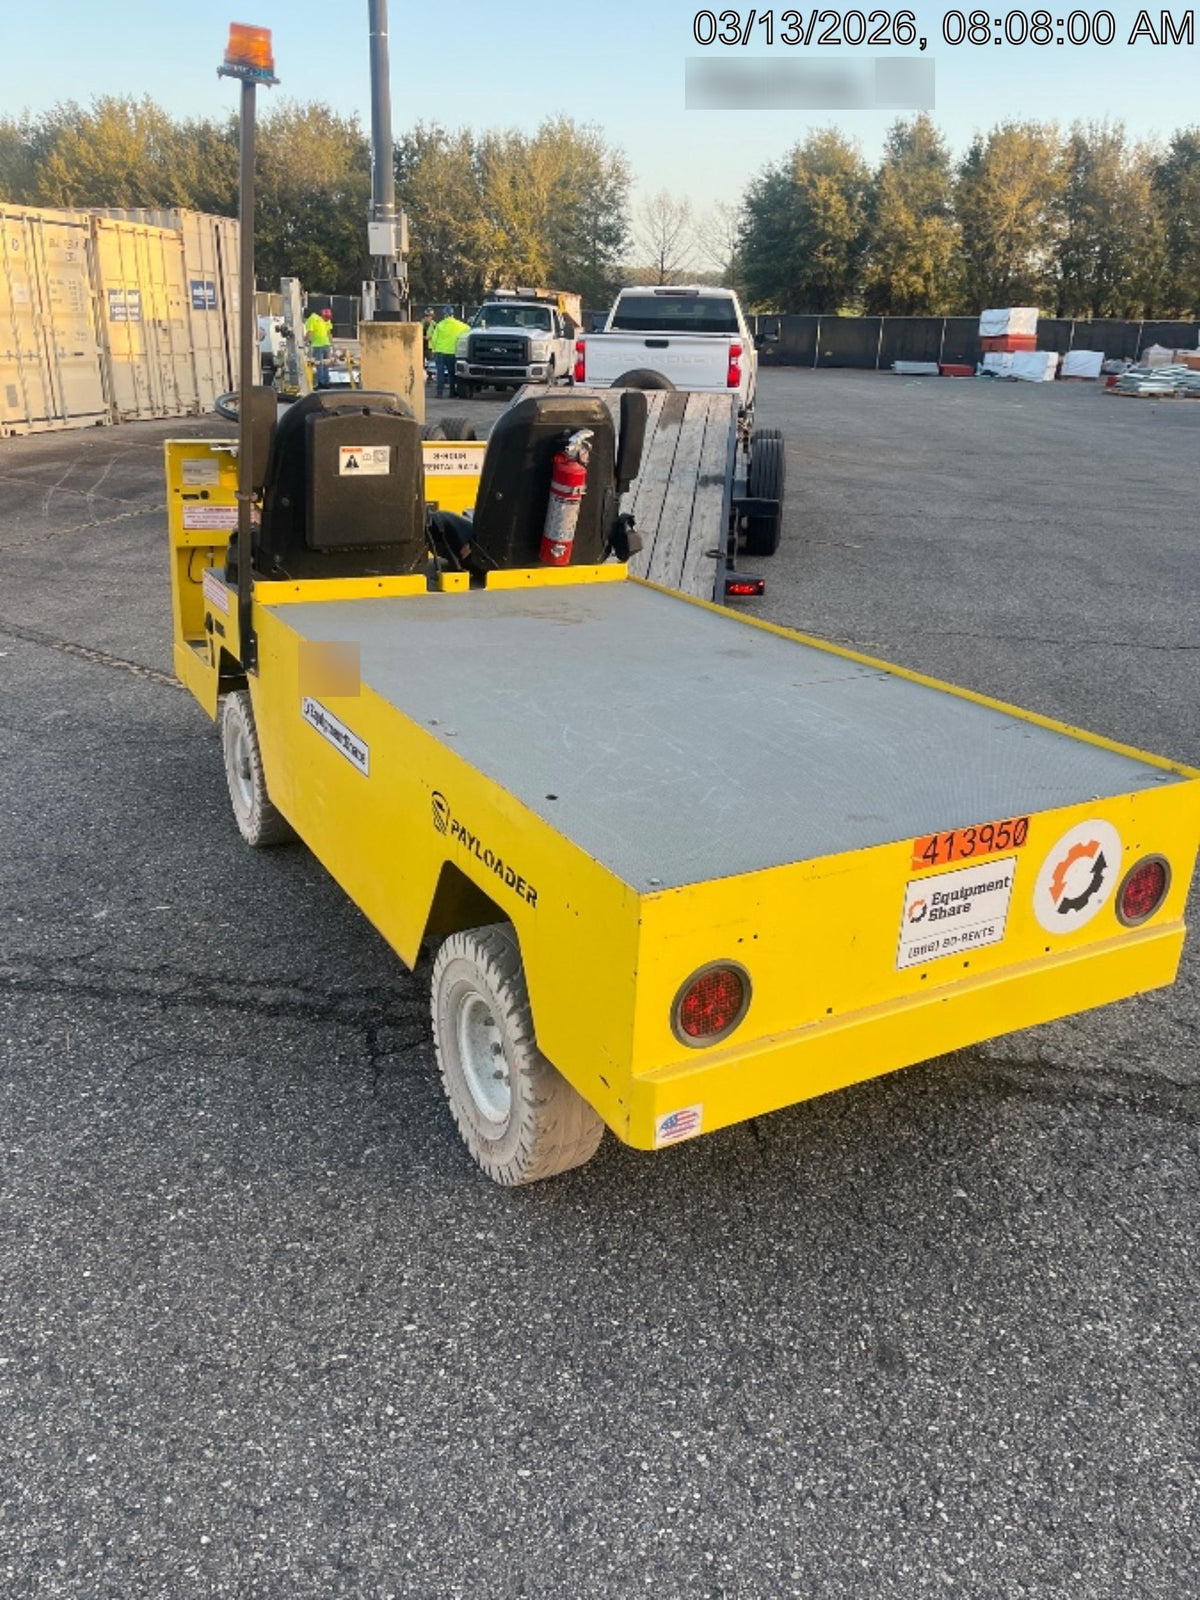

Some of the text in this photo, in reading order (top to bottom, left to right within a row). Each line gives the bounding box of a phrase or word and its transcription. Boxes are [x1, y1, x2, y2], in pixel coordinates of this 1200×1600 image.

[921, 817, 1030, 865] 413950
[450, 818, 538, 909] PAYLOADER
[931, 876, 1011, 906] Equipment
[927, 902, 972, 922] Share
